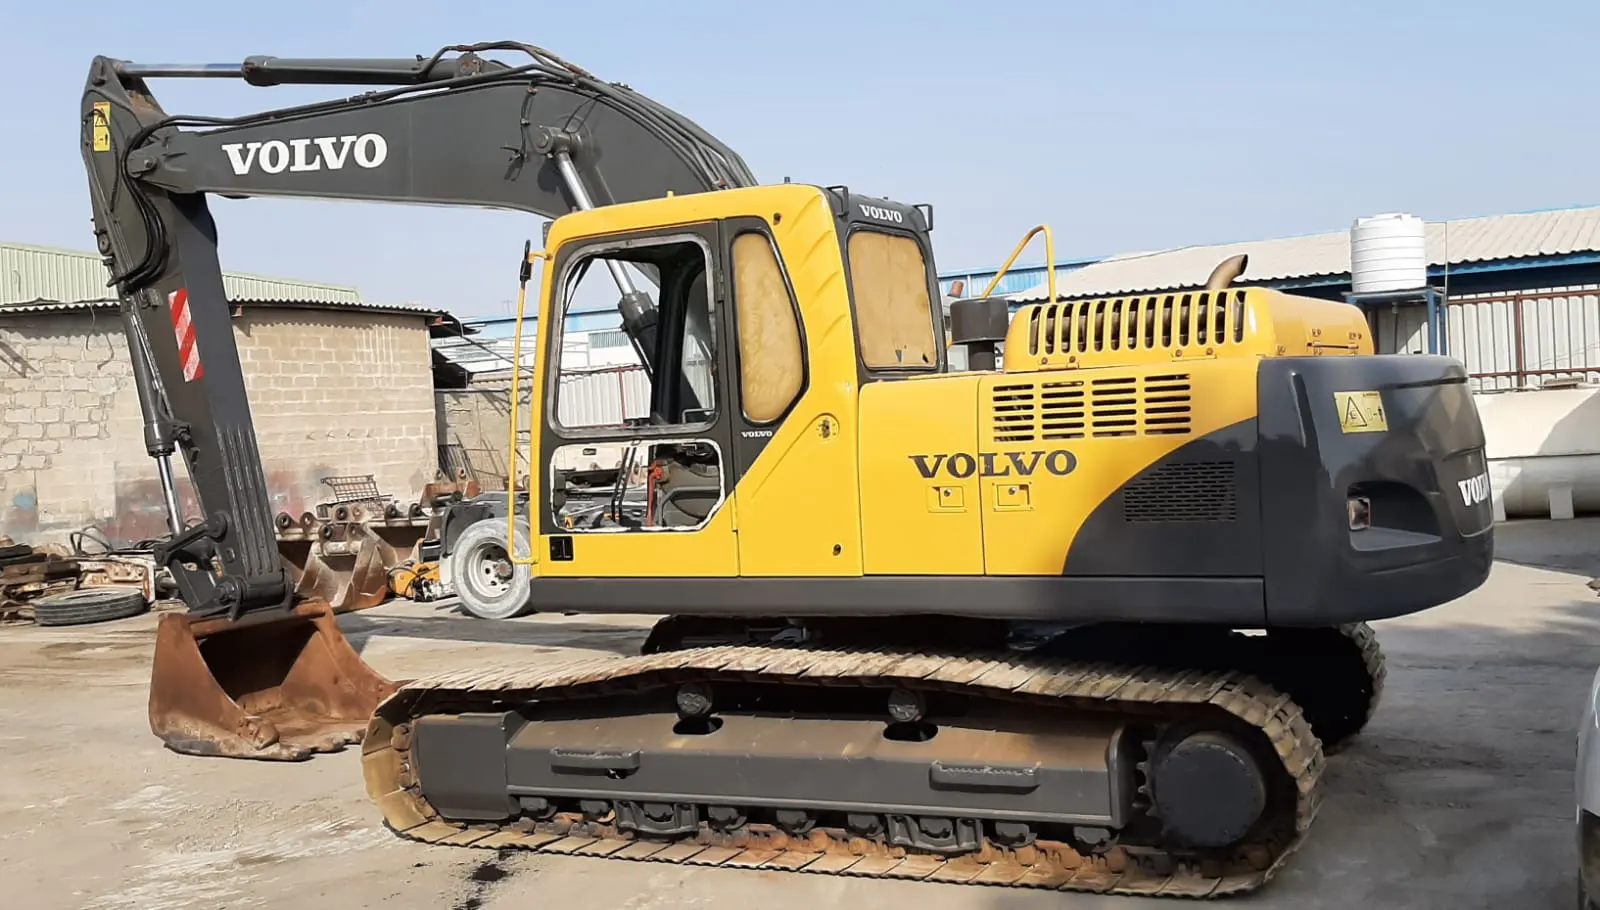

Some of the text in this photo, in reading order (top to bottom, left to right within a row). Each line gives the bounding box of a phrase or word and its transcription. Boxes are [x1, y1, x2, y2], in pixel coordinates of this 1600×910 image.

[222, 133, 388, 175] VOLVO
[858, 204, 903, 223] VOLVO
[741, 430, 773, 438] VOLVO
[908, 450, 1077, 478] VOLVO
